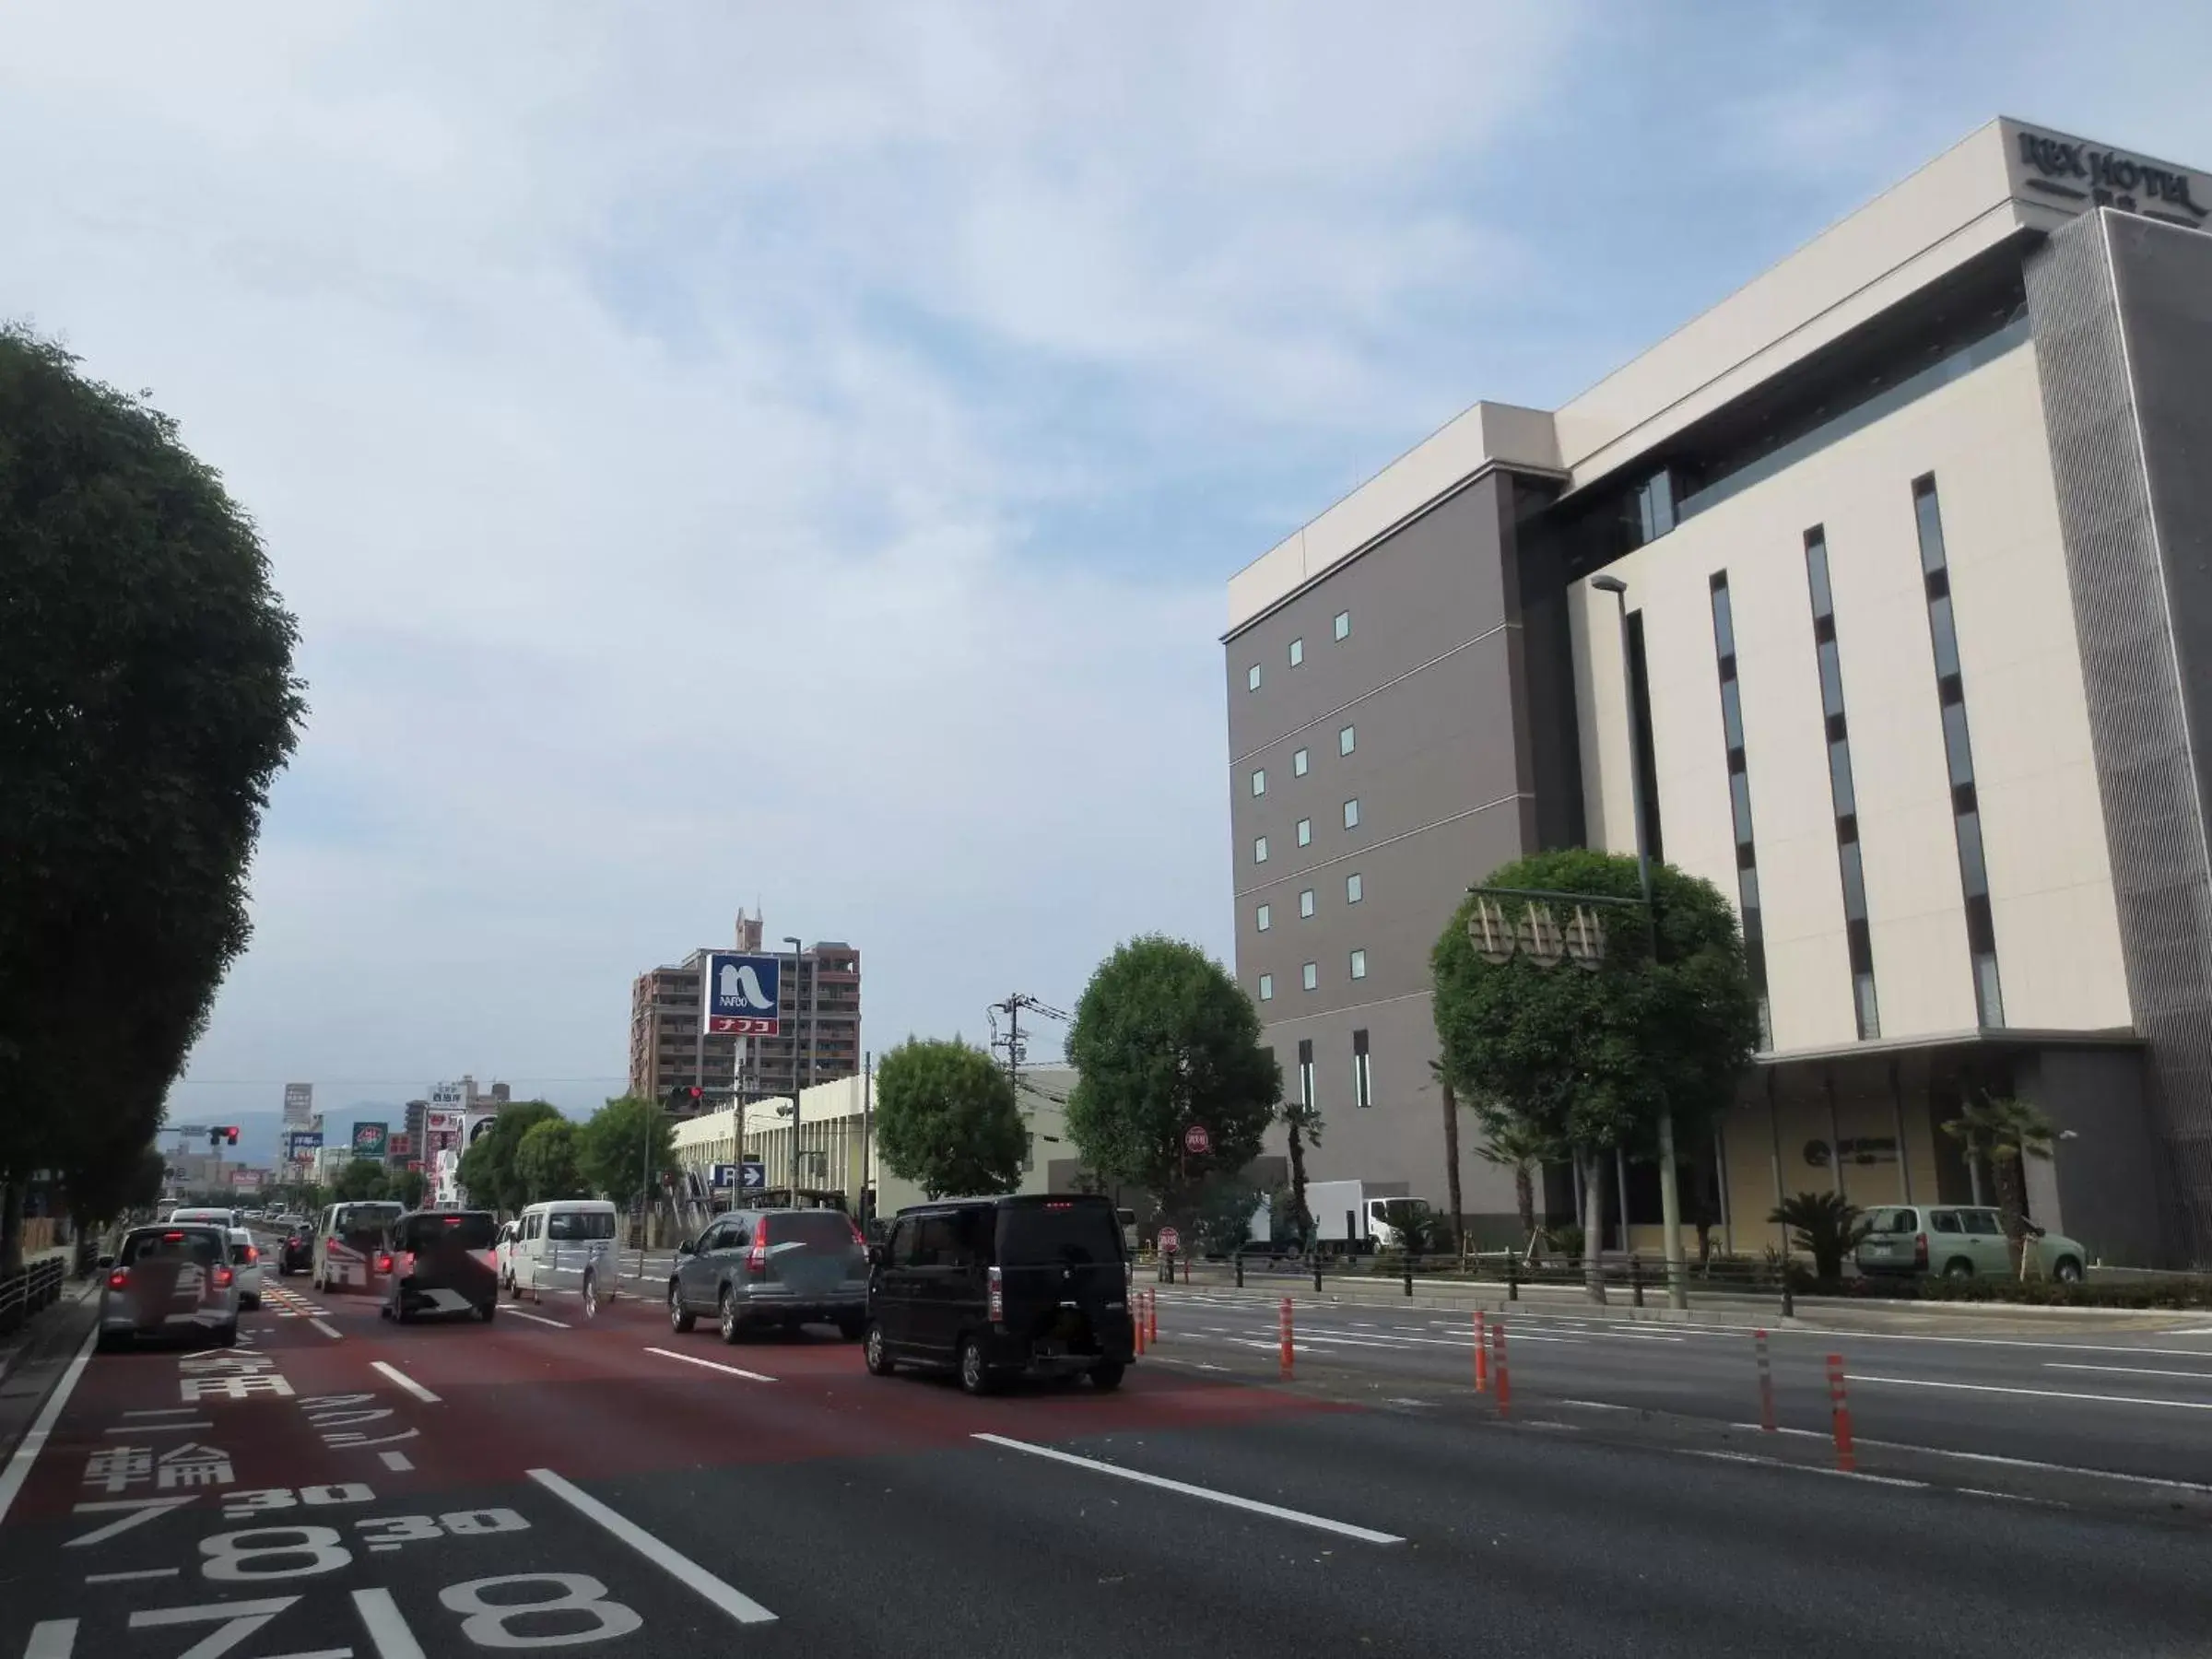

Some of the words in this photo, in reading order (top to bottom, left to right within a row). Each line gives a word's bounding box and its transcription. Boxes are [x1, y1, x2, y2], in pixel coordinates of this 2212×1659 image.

[2017, 131, 2088, 177] REX
[2088, 151, 2209, 218] HOTEL
[719, 1018, 769, 1032] ナフコ
